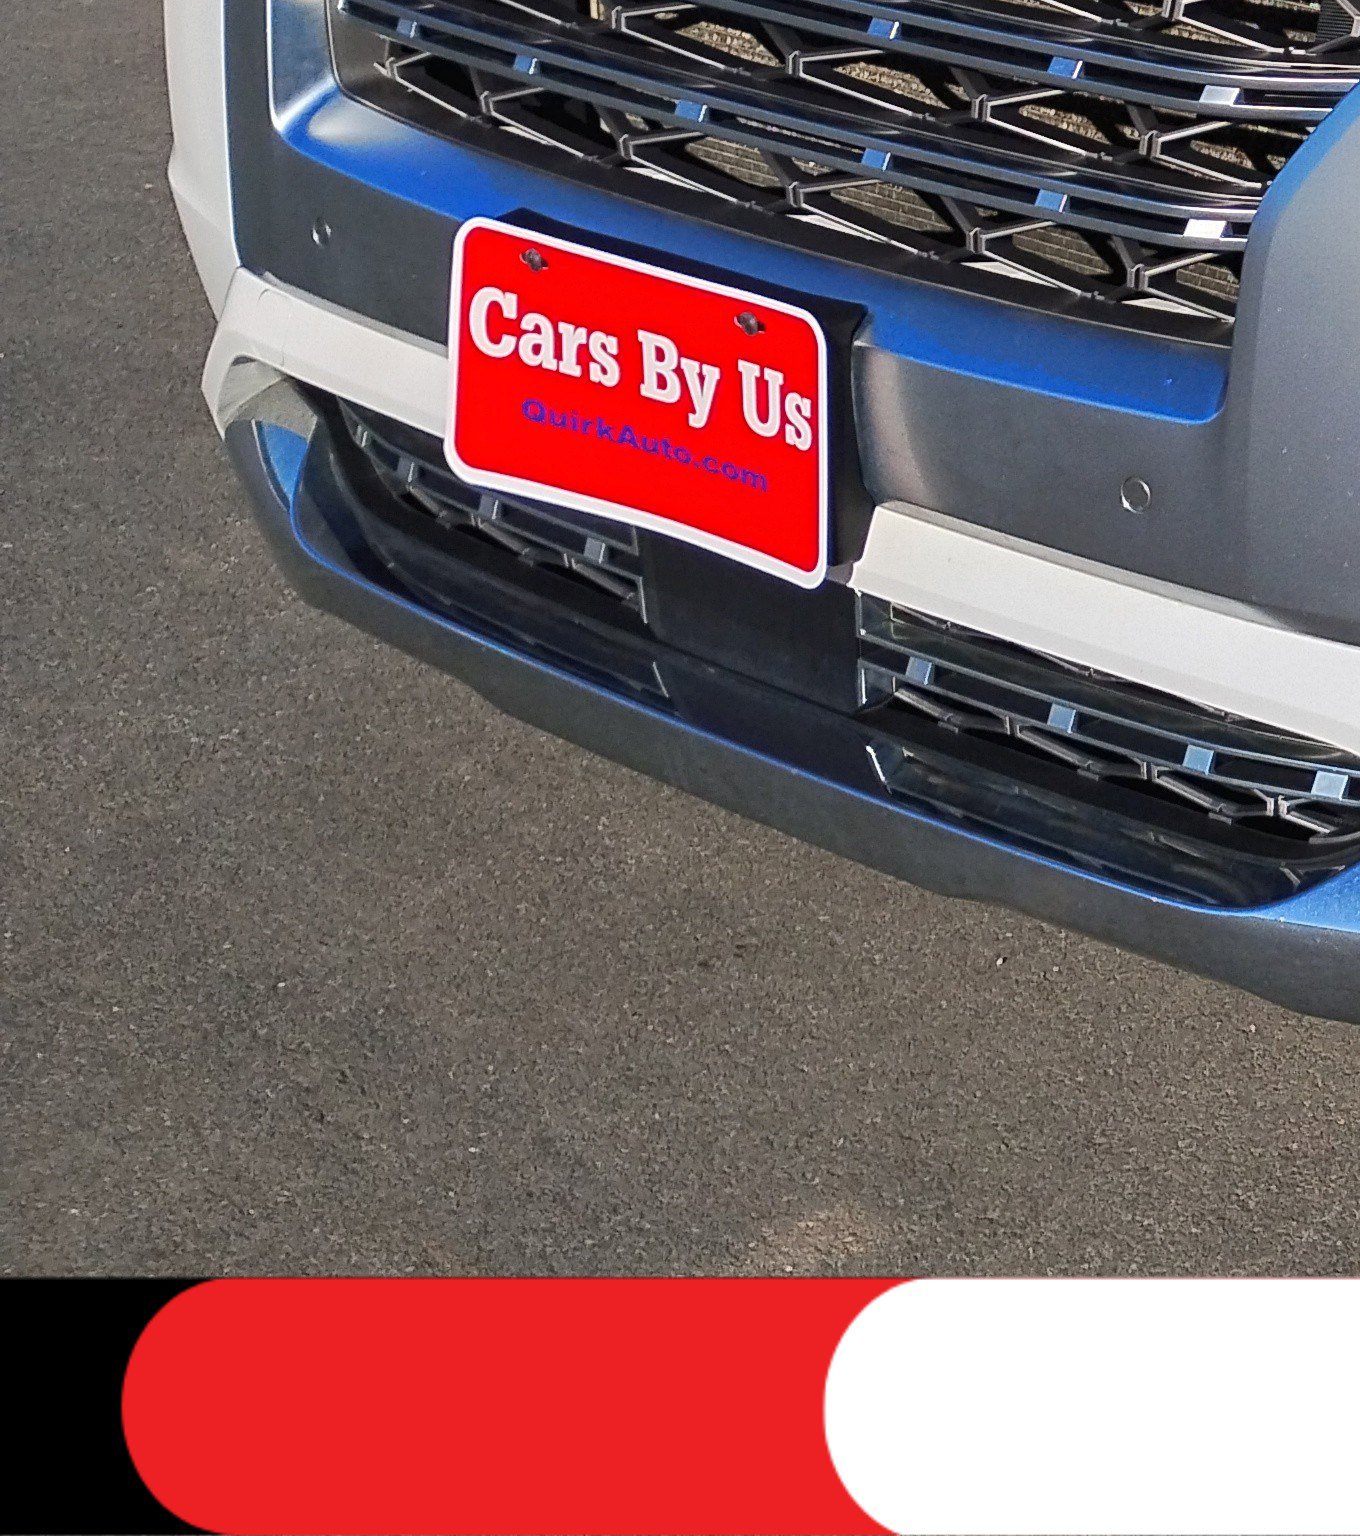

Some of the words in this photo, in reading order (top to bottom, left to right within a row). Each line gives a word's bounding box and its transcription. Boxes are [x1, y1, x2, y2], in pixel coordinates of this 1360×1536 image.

[468, 286, 621, 388] Cars
[637, 329, 721, 429] By
[737, 358, 813, 452] Us
[521, 397, 769, 493] QuirkAuto.com
